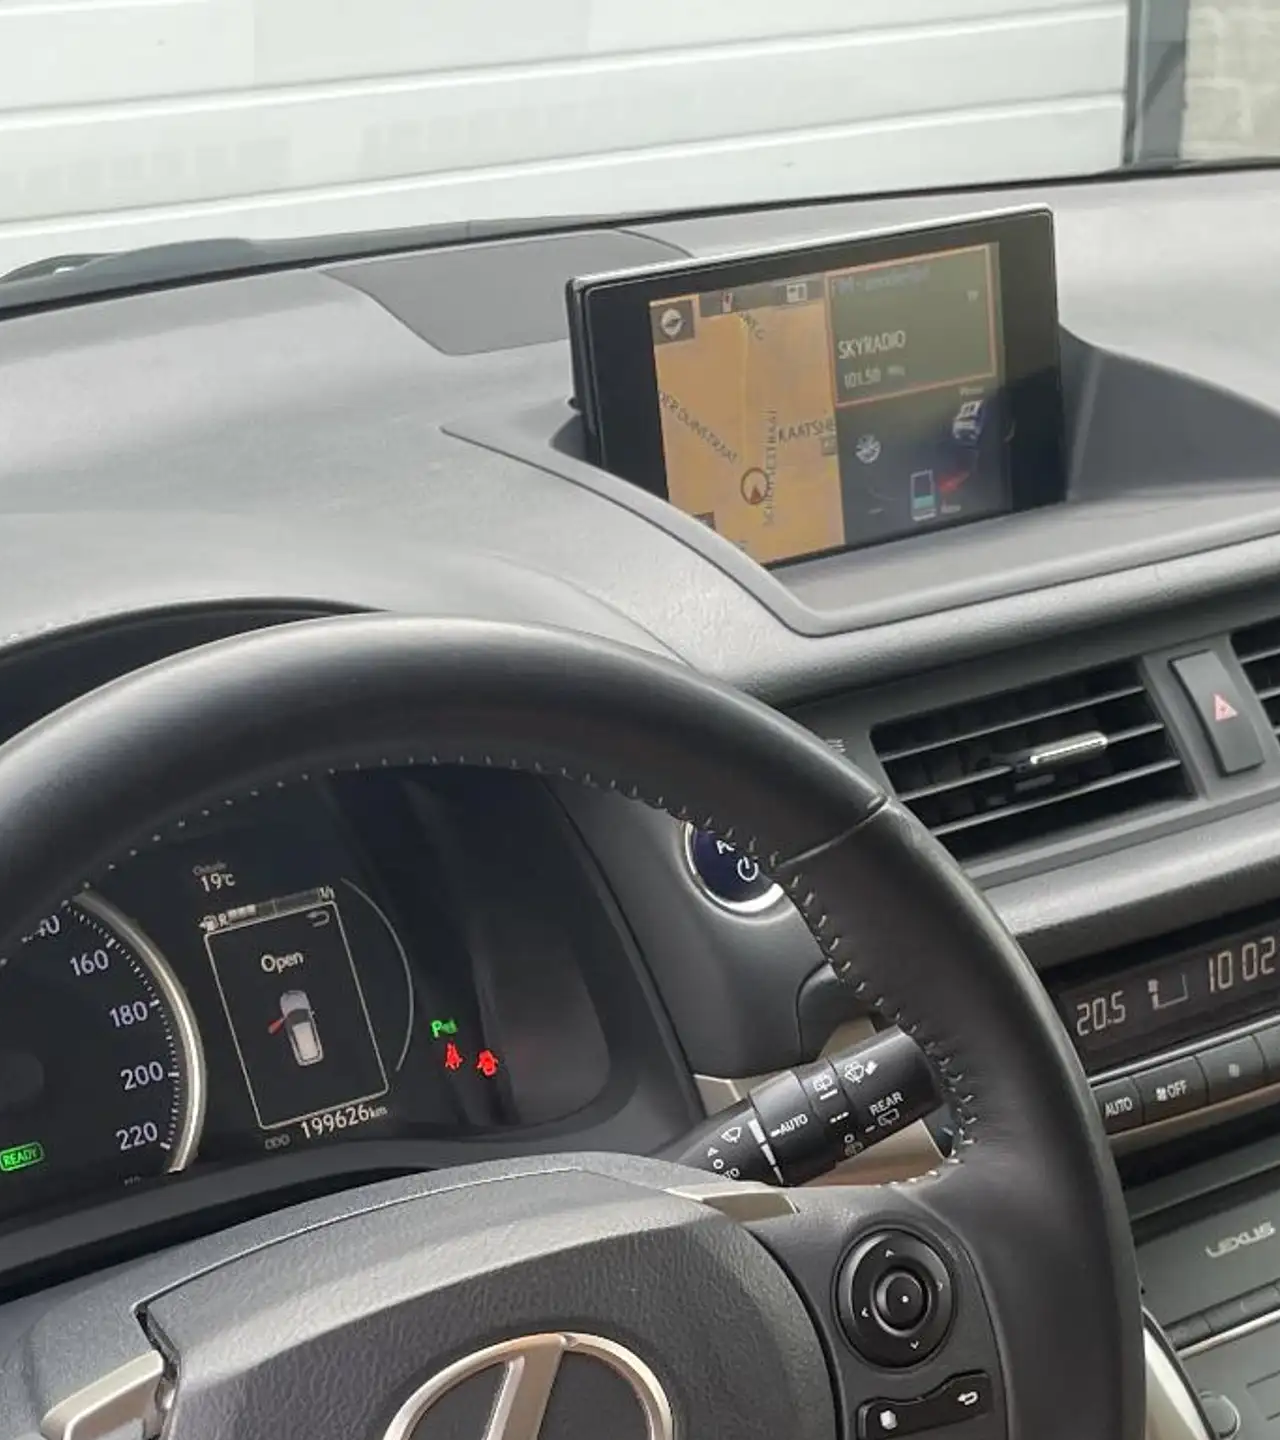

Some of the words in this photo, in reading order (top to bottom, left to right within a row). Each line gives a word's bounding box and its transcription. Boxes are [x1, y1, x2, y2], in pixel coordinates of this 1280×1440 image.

[838, 330, 906, 359] SKYRADIO
[70, 949, 109, 976] 160
[261, 949, 305, 975] Open
[109, 1001, 149, 1030] 180
[1076, 990, 1126, 1036] 20.5
[120, 1061, 163, 1091] 200
[1167, 1080, 1188, 1098] OFF
[870, 1091, 904, 1116] REAR
[1105, 1097, 1133, 1118] AUTO
[116, 1122, 158, 1150] 220
[780, 1114, 808, 1135] AUTO
[3, 1148, 38, 1167] READY
[1205, 1221, 1277, 1259] LEXUS
